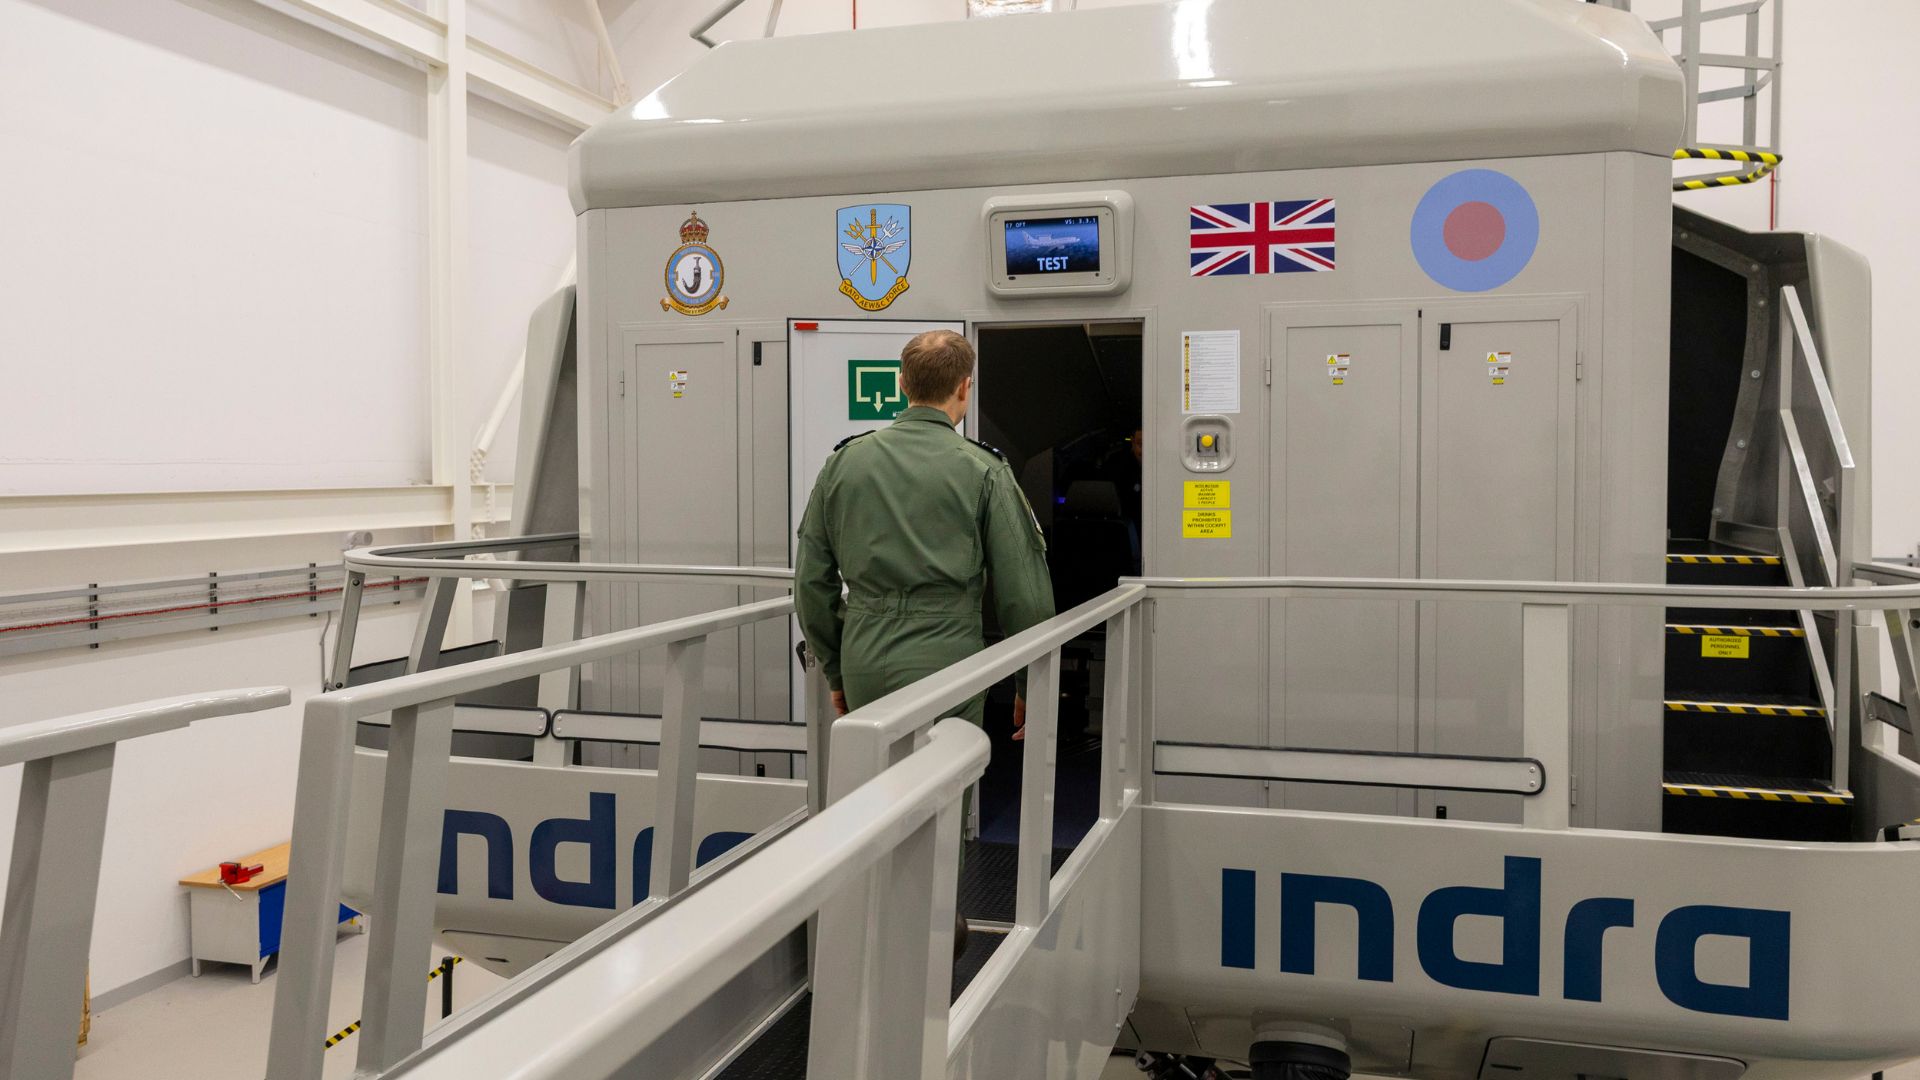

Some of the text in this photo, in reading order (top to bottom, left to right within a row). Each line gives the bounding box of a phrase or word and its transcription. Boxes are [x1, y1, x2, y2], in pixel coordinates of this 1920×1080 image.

[1037, 256, 1069, 271] TEST
[843, 283, 906, 309] NATO AEW&C FORCE
[1221, 855, 1791, 1021] indra
